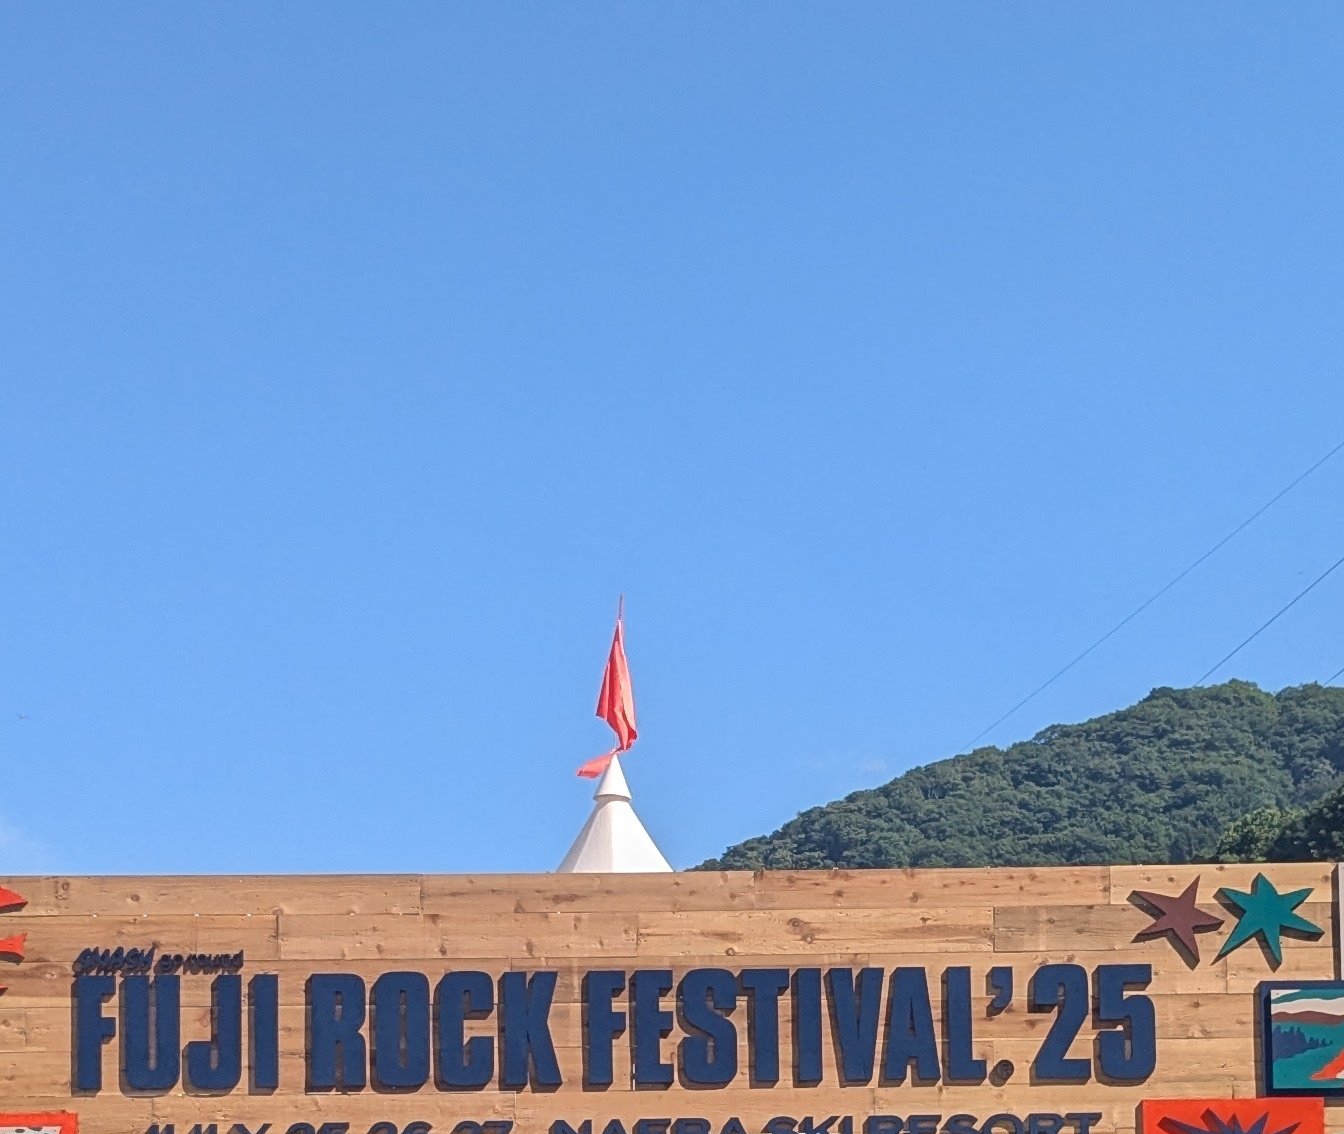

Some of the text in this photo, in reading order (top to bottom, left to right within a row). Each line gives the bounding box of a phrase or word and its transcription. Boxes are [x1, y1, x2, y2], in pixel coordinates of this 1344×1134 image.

[72, 973, 278, 1096] FUJI
[305, 970, 564, 1092] ROCK
[582, 966, 987, 1091] FESTIVAL
